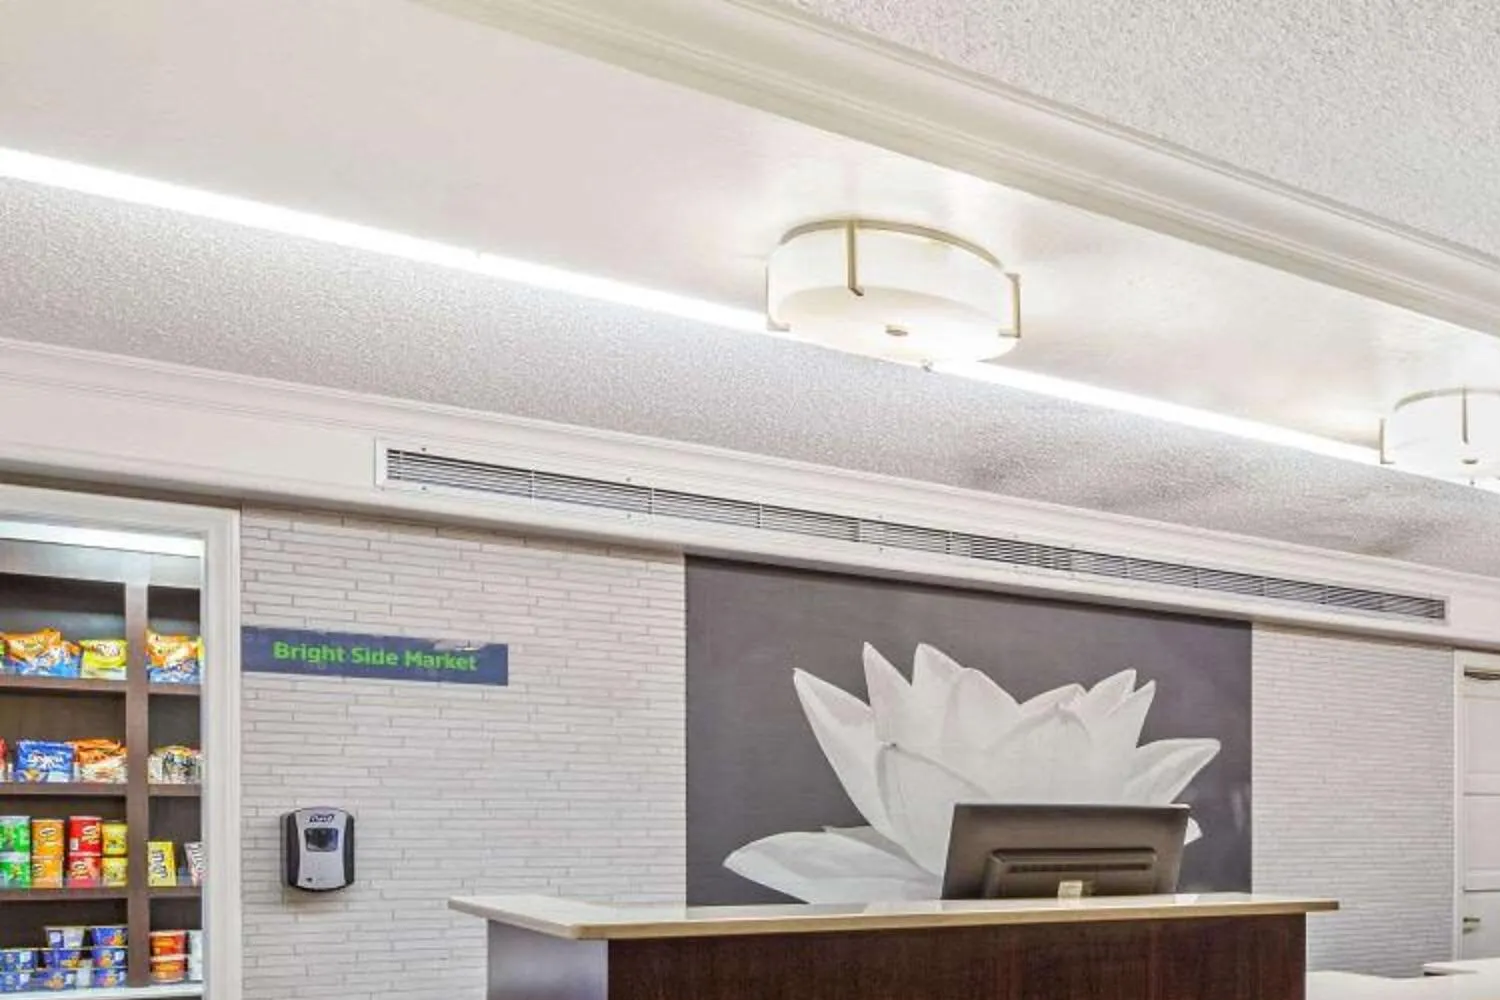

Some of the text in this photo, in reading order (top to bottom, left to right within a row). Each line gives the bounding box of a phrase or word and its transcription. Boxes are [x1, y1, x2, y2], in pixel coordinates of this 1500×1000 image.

[272, 641, 477, 670] Bright Side Market
